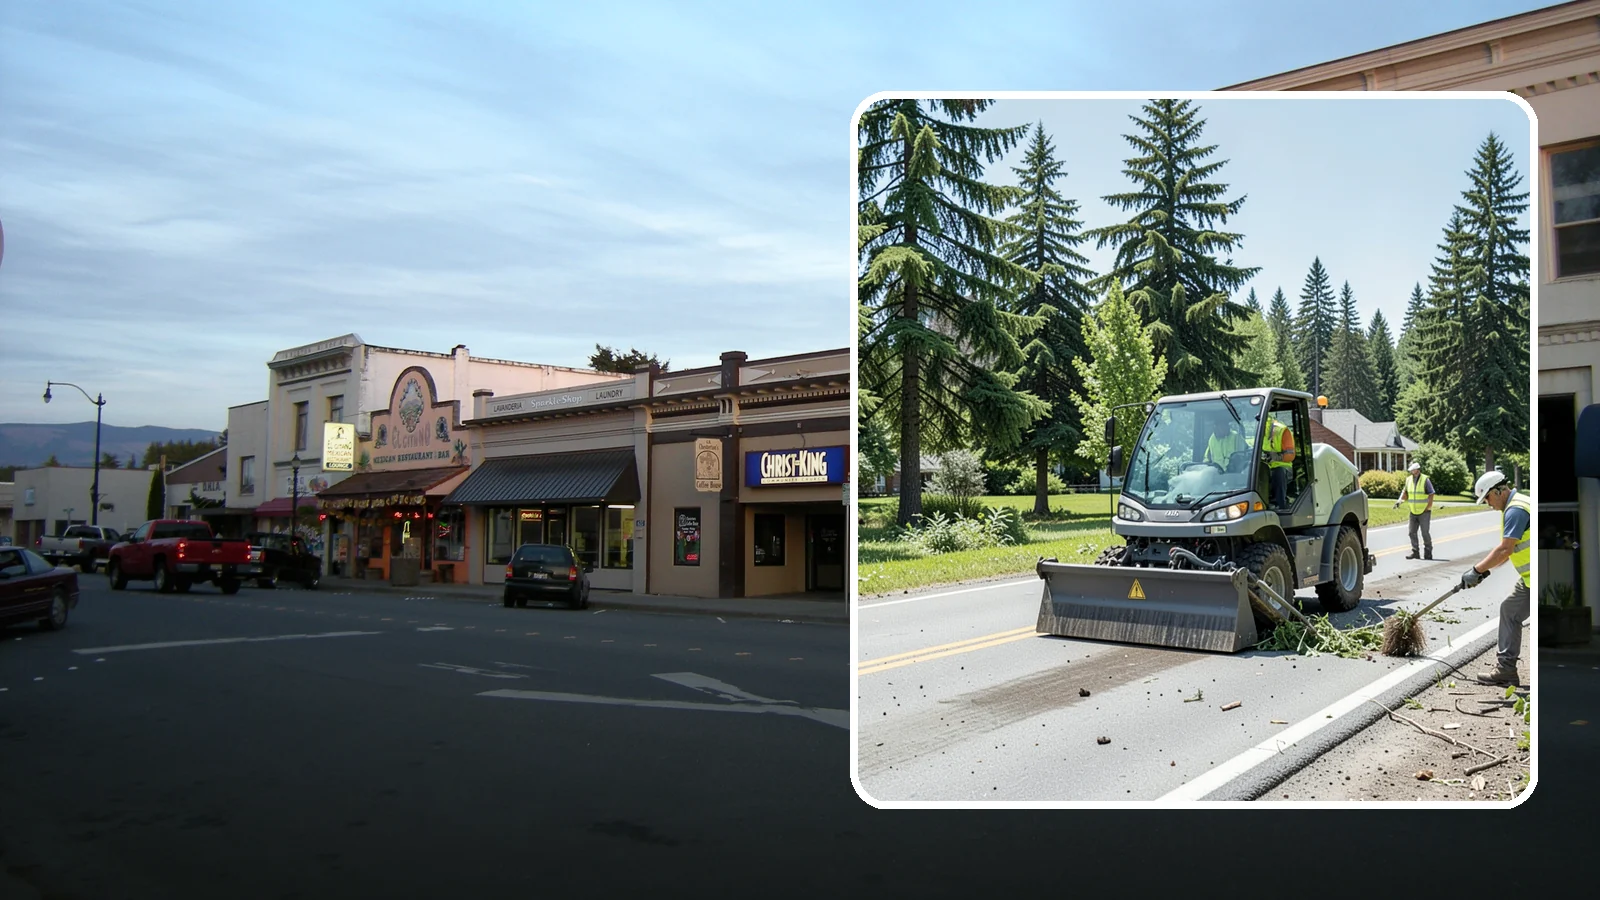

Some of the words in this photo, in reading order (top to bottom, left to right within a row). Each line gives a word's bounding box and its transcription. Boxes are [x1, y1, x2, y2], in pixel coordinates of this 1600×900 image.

[493, 402, 522, 412] LAVANDERIA
[531, 399, 560, 409] Sparkle
[562, 394, 582, 405] Shop
[595, 389, 623, 400] LAUNDRY
[373, 455, 396, 464] MEXICAN
[397, 451, 433, 463] RESTAURANT
[438, 450, 450, 459] BAR
[760, 452, 798, 478] CHRIST
[799, 450, 827, 477] KING
